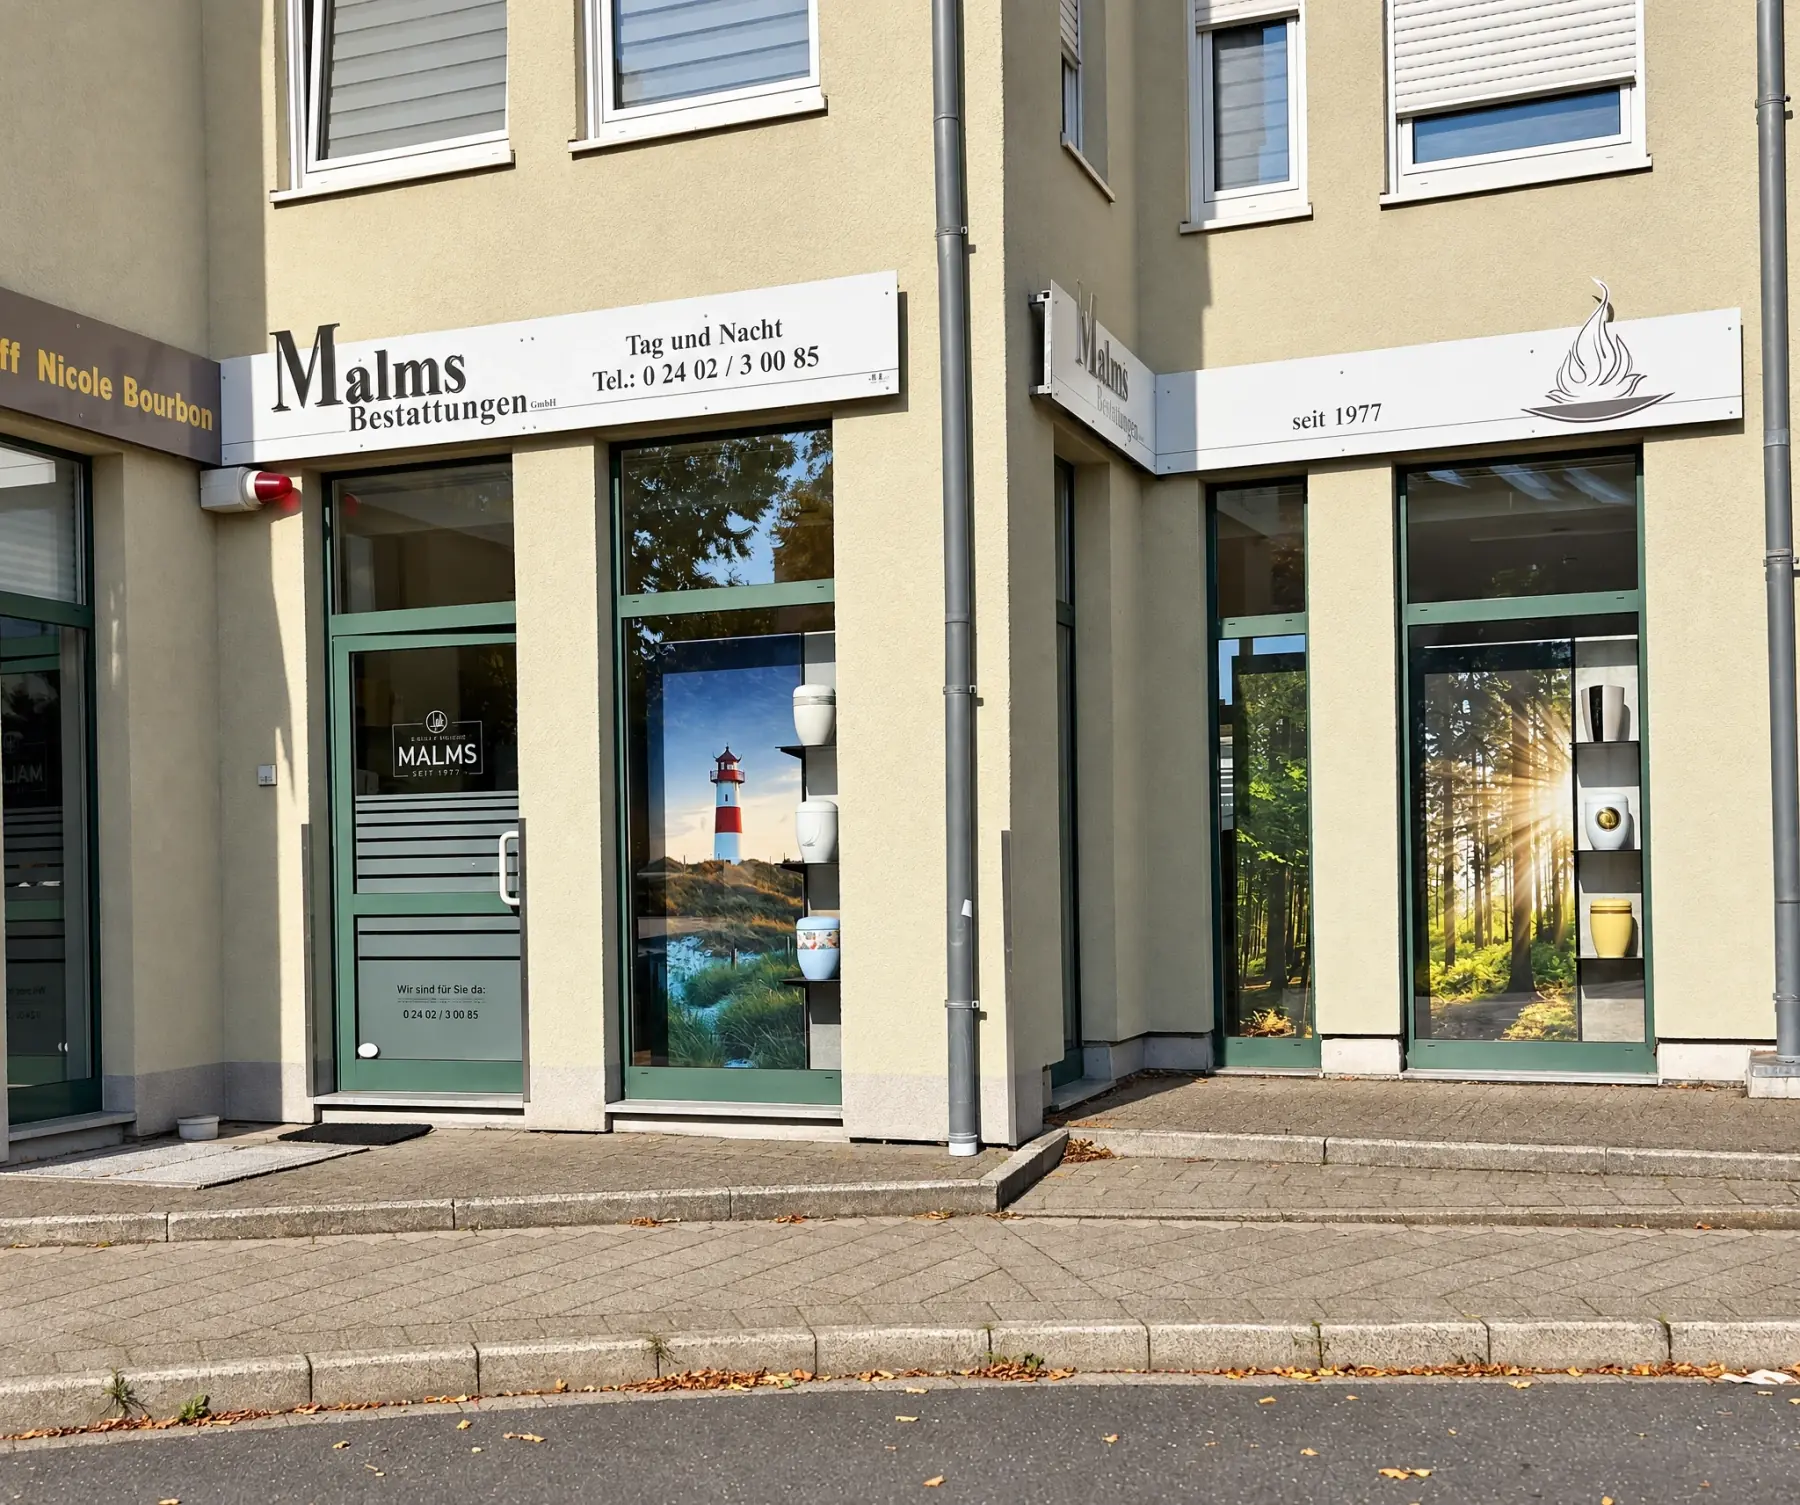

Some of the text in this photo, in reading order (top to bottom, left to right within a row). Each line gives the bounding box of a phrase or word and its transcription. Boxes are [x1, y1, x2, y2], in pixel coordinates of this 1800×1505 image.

[626, 318, 783, 358] Tag und Nacht
[1075, 279, 1129, 402] Malms
[269, 323, 466, 412] Malms
[592, 345, 820, 392] Tel.: 0 24 02 / 3 00 85
[38, 349, 113, 400] Nicole
[123, 375, 213, 430] Bourbon
[349, 394, 557, 432] Bestattungen GmbH
[1292, 403, 1382, 430] seit 1977
[398, 743, 477, 767] MALMS
[412, 768, 460, 777] SEIT 1977
[397, 984, 486, 994] Wir sind für Sie da:
[403, 1009, 479, 1020] 0 24 02 / 3 00 85
